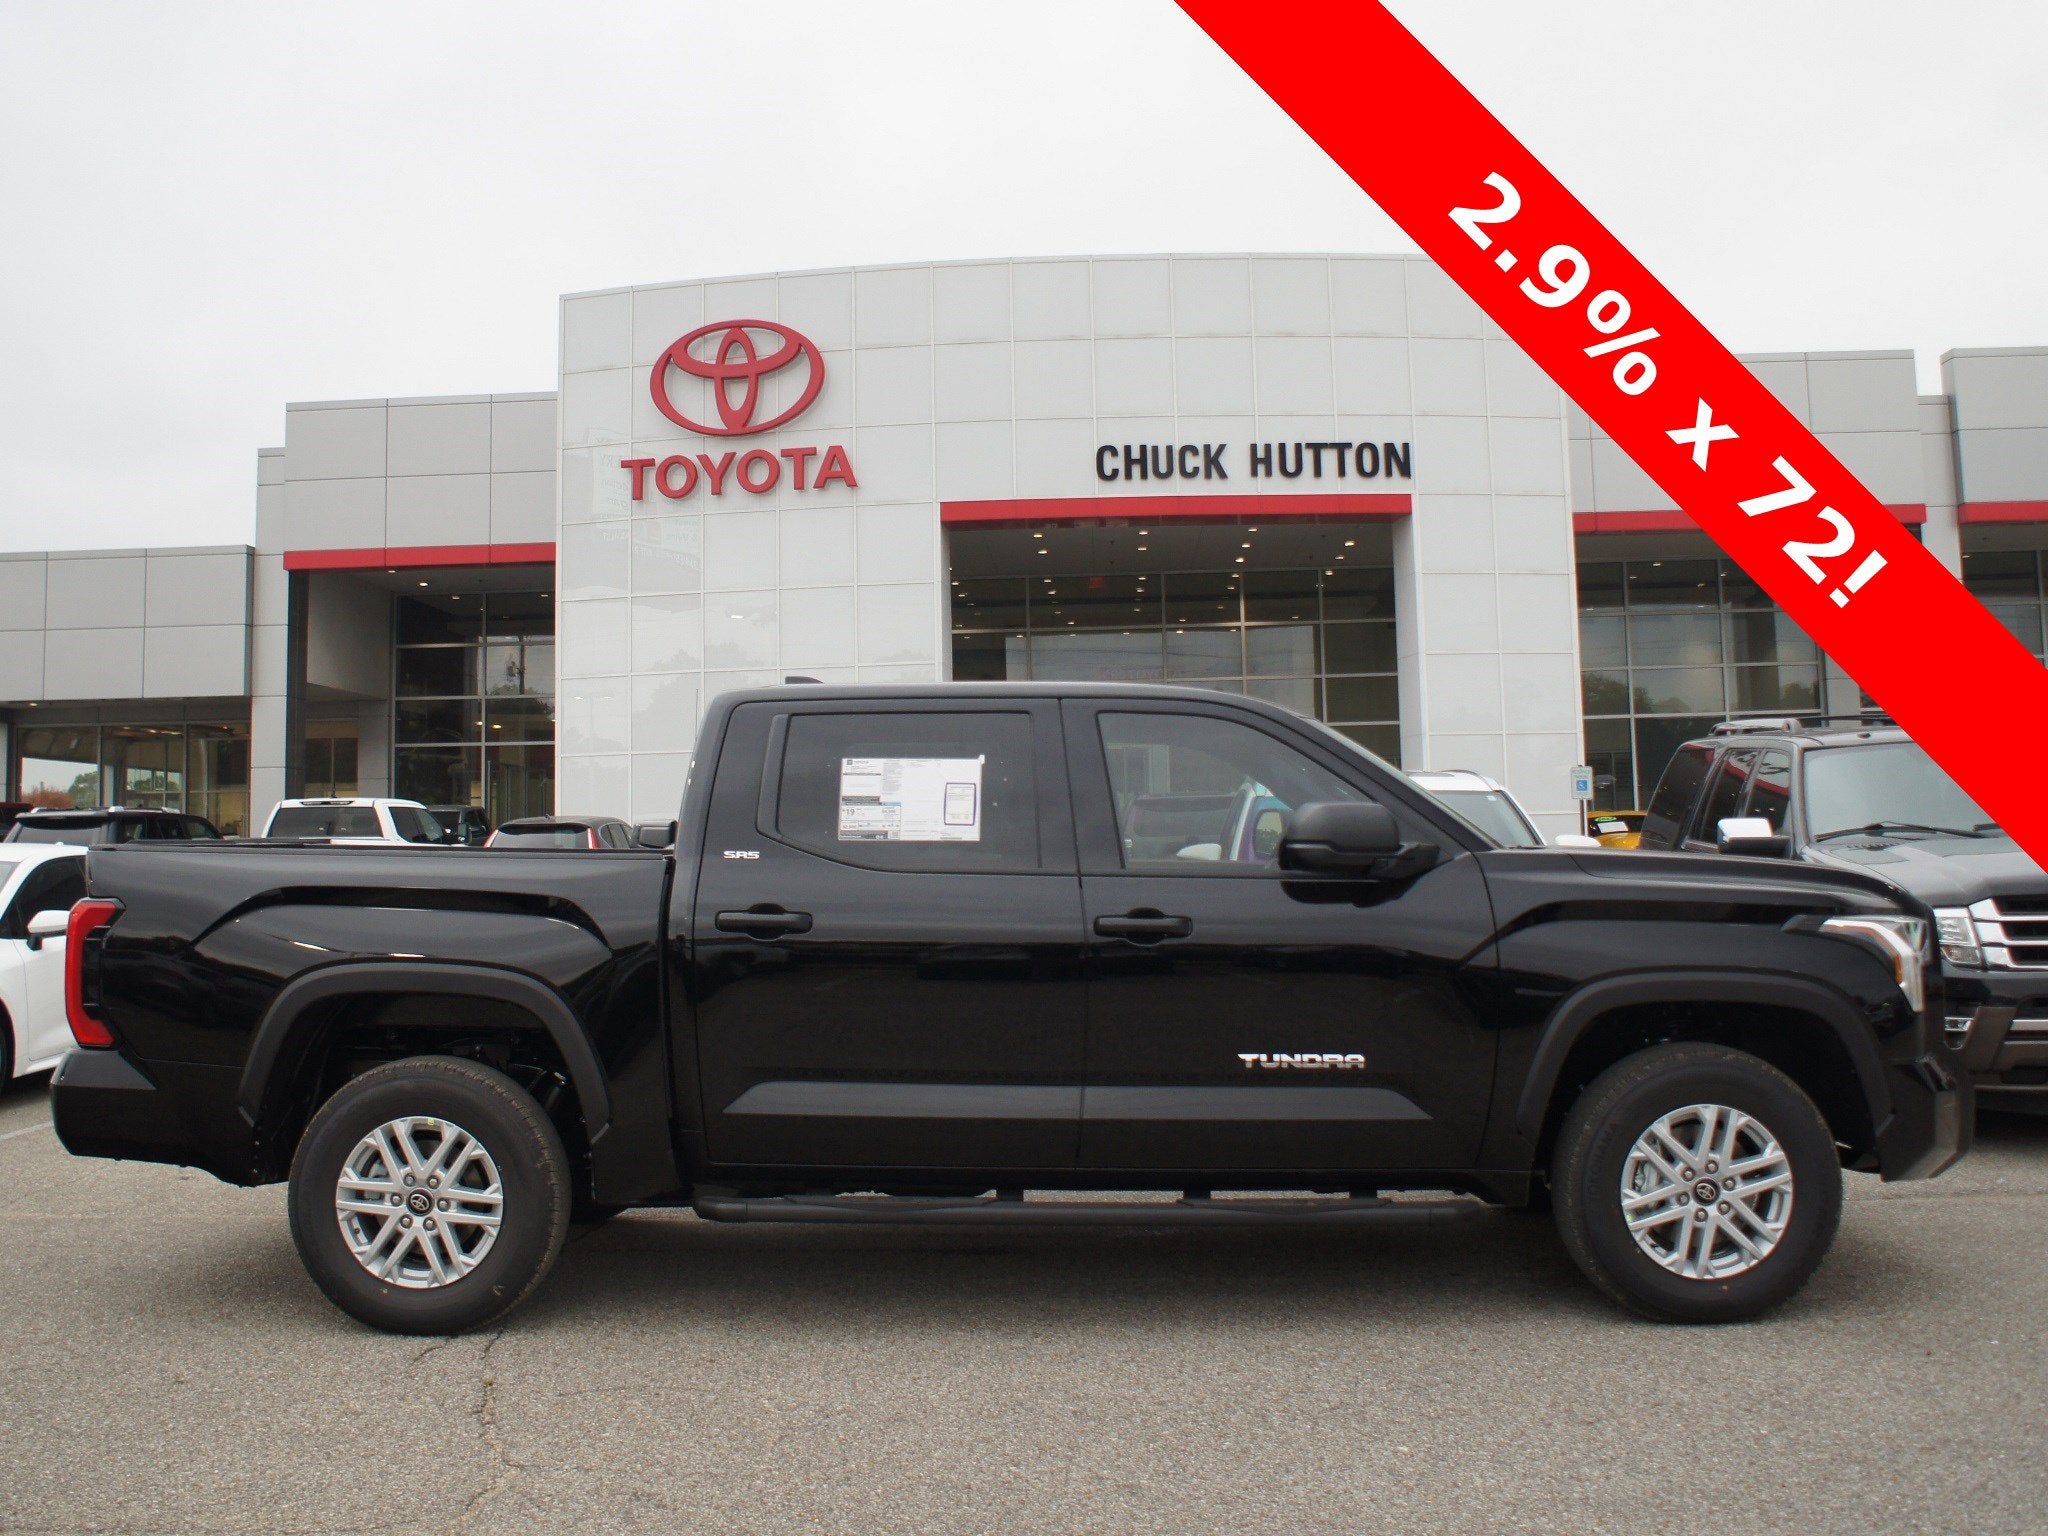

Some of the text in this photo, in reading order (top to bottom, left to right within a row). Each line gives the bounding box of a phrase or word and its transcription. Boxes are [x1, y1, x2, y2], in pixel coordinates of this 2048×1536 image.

[621, 445, 858, 501] TOYOTA
[1095, 442, 1412, 482] CHUCK HUTTON
[723, 850, 760, 860] SR5
[1237, 1053, 1366, 1070] TUNDRA
